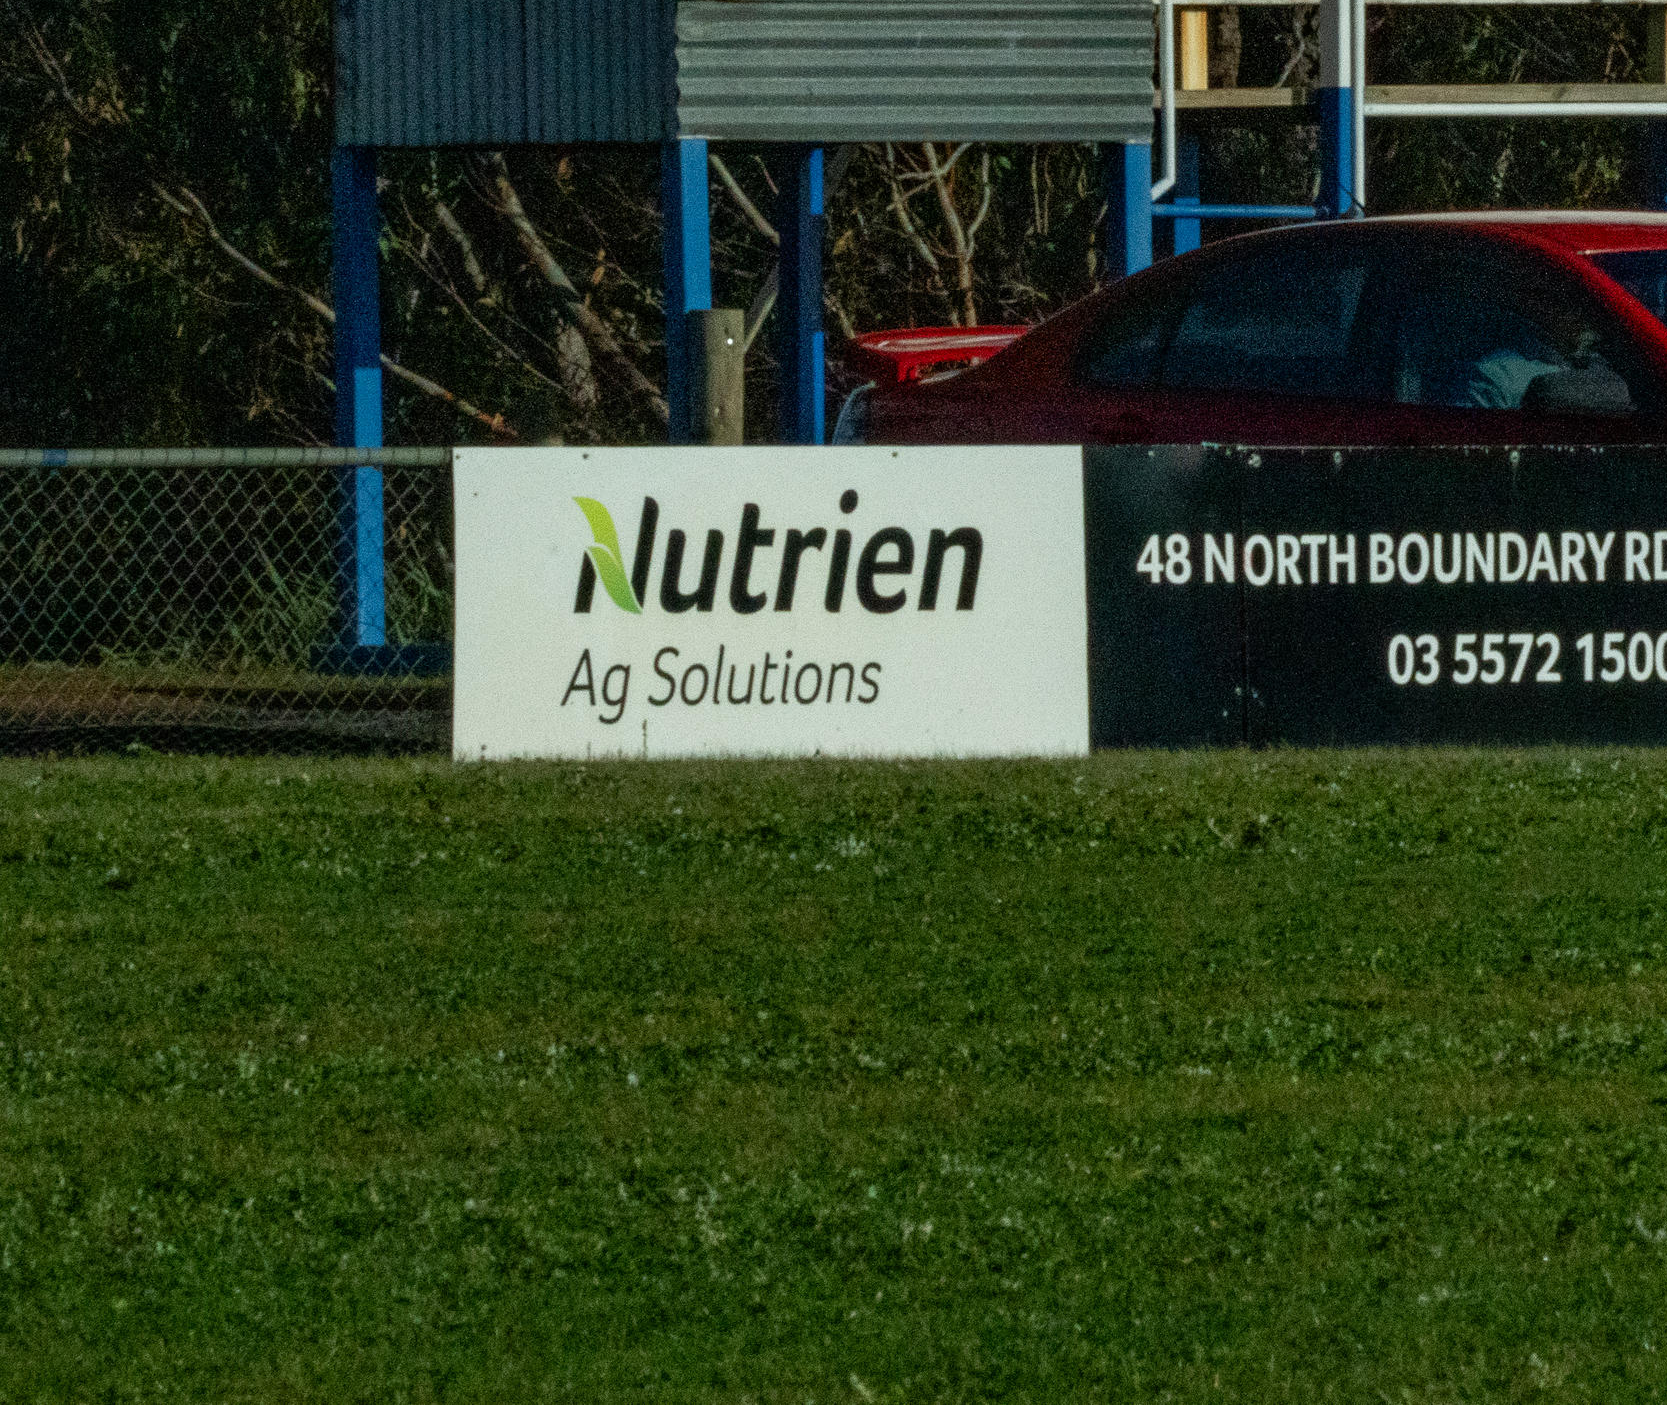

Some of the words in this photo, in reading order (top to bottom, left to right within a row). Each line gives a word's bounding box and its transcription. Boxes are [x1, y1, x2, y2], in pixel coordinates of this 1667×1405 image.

[571, 489, 984, 614] Nutrien
[1136, 534, 1191, 584] 48
[1203, 533, 1356, 584] NORTH
[1369, 531, 1617, 583] BOUNDARY
[561, 648, 631, 725] Ag
[648, 644, 882, 706] Solutions
[1388, 633, 1439, 685] 03
[1452, 633, 1562, 685] 5572
